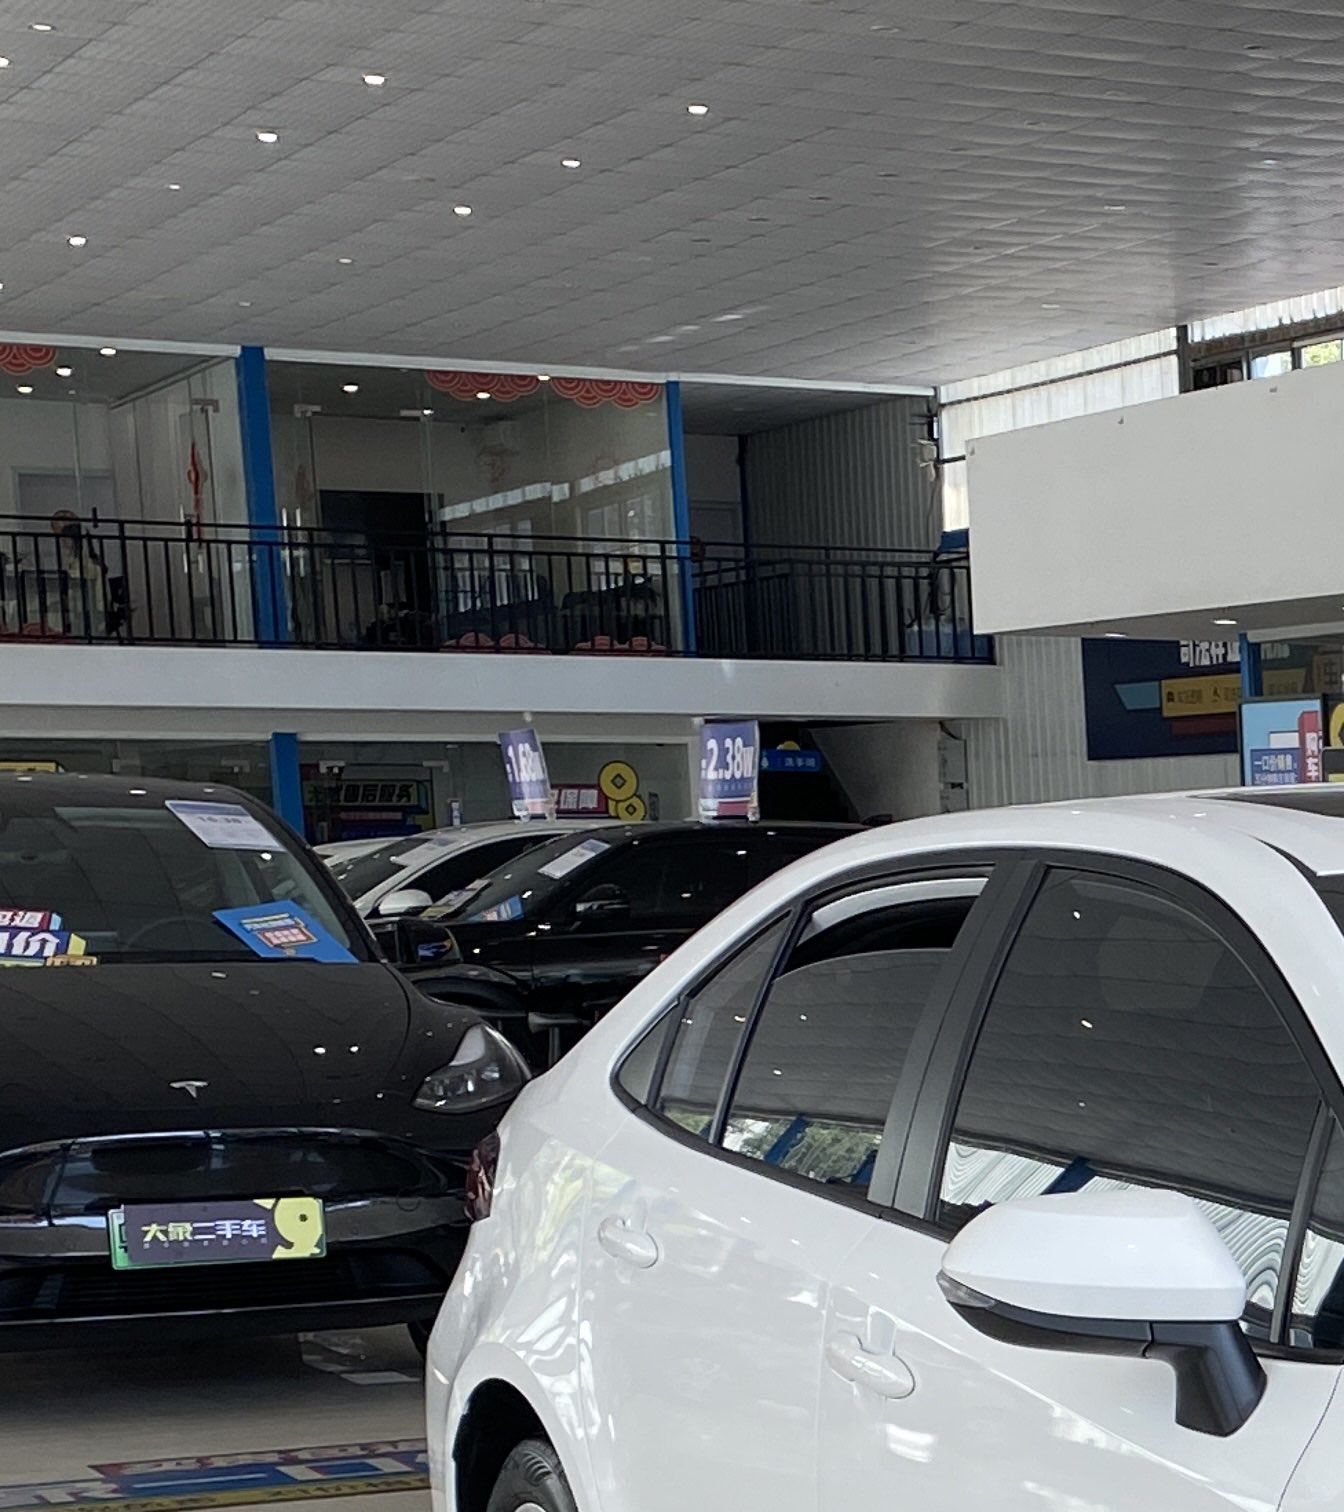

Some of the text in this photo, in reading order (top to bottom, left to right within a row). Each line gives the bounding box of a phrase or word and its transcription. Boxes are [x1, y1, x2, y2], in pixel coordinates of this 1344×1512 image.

[140, 1218, 268, 1243] 大象二手车
